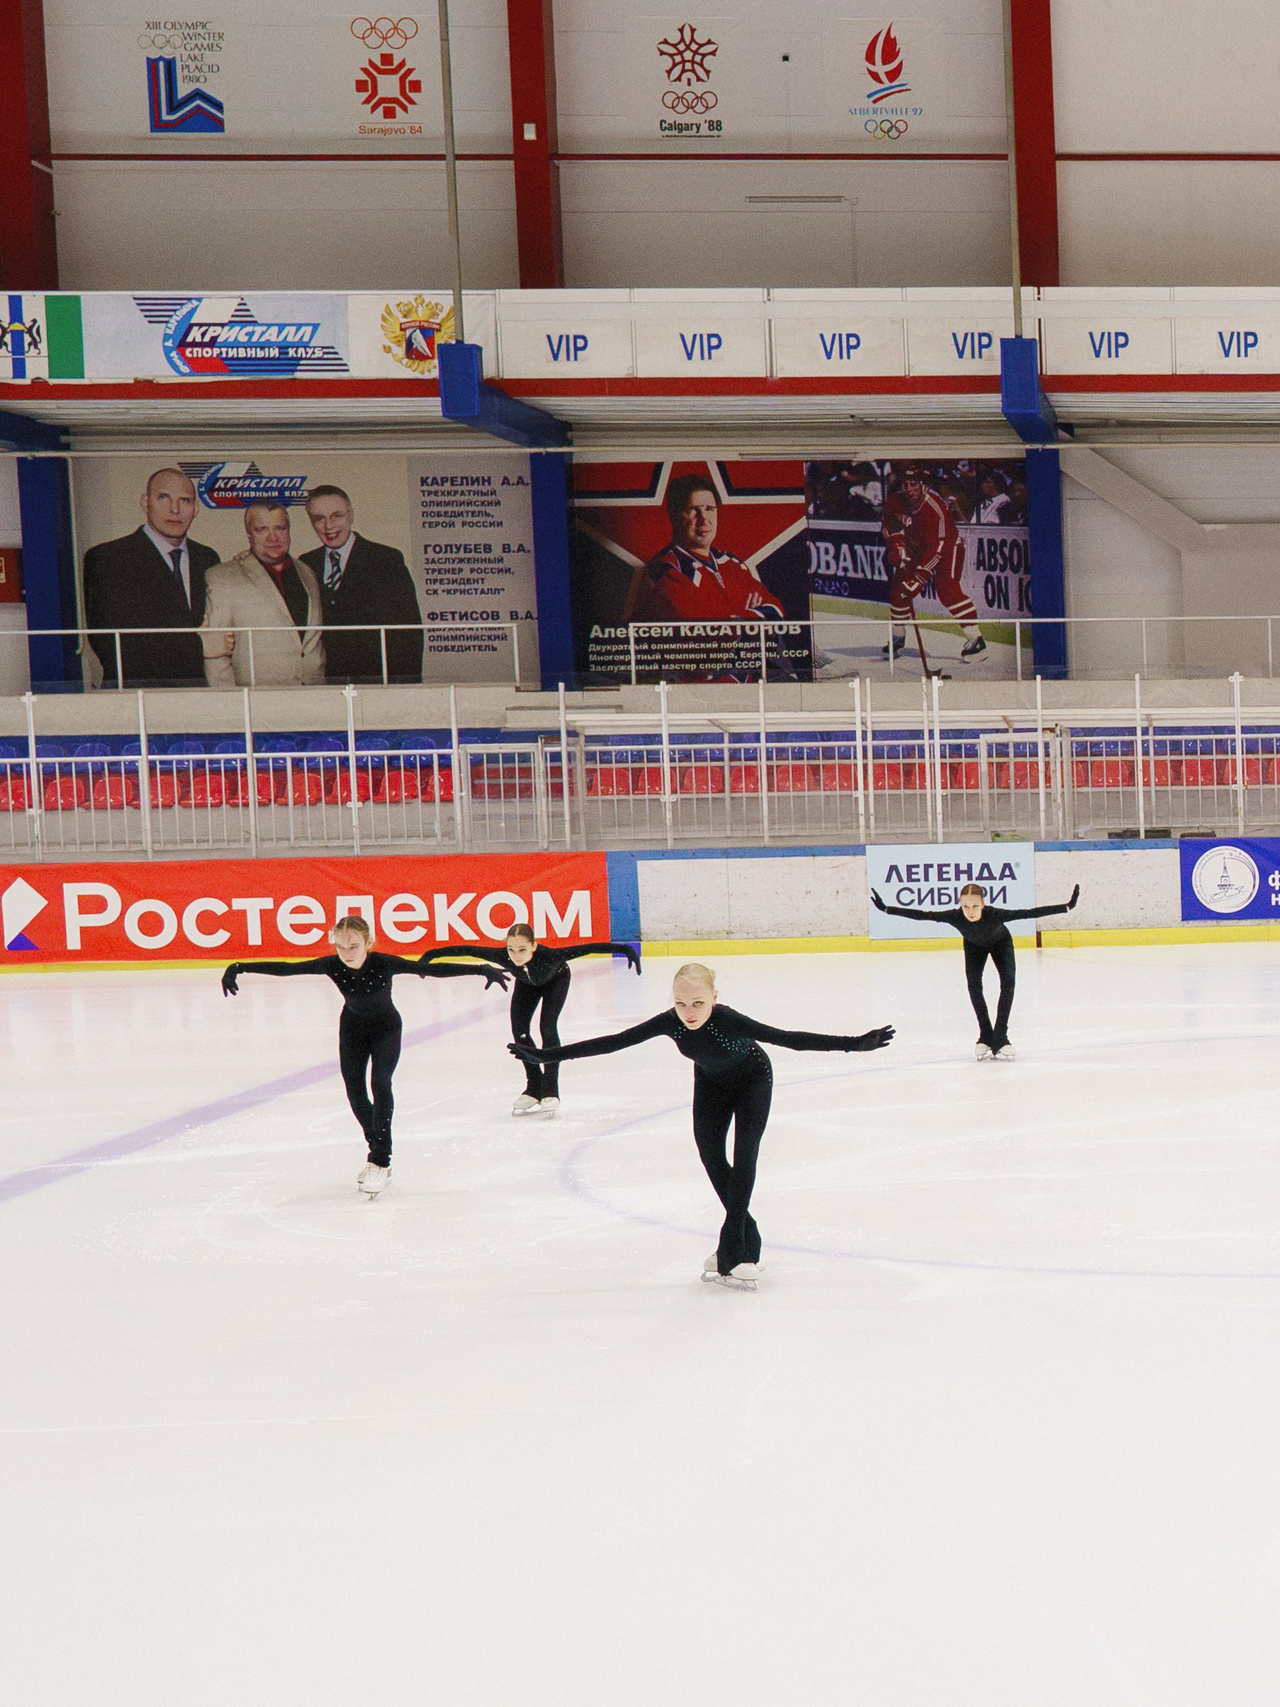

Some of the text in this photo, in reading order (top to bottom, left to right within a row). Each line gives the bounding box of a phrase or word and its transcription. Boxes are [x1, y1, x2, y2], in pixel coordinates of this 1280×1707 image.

[145, 21, 213, 31] XIII OLYMPIC
[181, 32, 225, 41] WINTER
[183, 43, 222, 52] GAMES
[180, 53, 205, 63] LAKE
[181, 64, 220, 73] PLACID
[182, 75, 208, 84] 1980
[849, 107, 909, 116] ALBERTVILLE
[358, 125, 423, 136] Sarajevo '84
[660, 119, 723, 134] Calgary '88
[186, 325, 313, 342] КРИСТАЛЛ
[546, 333, 589, 363] VIP
[680, 333, 723, 361] VIP
[819, 333, 861, 360] VIP
[952, 331, 993, 360] VIP
[1088, 331, 1130, 358] VIP
[1217, 331, 1259, 358] VIP
[185, 346, 324, 358] СПОРТИВНЫЙ КЛУБ
[215, 478, 302, 488] КРИСТАЛЛ
[420, 475, 530, 487] КАРЕЛИН А.А.
[213, 490, 279, 498] СПОРТИВНЫЙ
[421, 488, 498, 498] ТРЕХКРАТНЫЙ
[421, 499, 501, 508] ОЛИМПИЙСКИЙ
[421, 509, 494, 519] ПОБЕДИТЕЛЬ,
[422, 520, 504, 529] ГЕРОЙ РОССИИ
[424, 543, 531, 555] ГОЛУБЕВ В.А.
[424, 556, 505, 565] ЗАСЛУЖЕННЫЙ
[425, 567, 515, 575] ТРЕНЕР РОССИИ,
[425, 577, 486, 586] ПРЕЗИДЕНТ
[426, 588, 439, 596] СК
[984, 574, 1010, 611] ON
[427, 610, 538, 621] ФЕТИСОВ В.А.
[680, 625, 802, 637] КАСАТОНОВ
[428, 632, 508, 642] ОЛИМПИЙСКИЙ
[429, 645, 498, 653] ПОБЕДИТЕЛЬ
[588, 640, 778, 652] Двукратый олимпийский победитль
[588, 652, 662, 662] Многокртный
[664, 652, 707, 660] чемпион
[709, 651, 738, 660] мира,
[782, 649, 810, 658] СССР
[662, 662, 697, 672] мастер
[699, 662, 733, 670] спорта
[735, 660, 762, 669] СССР
[885, 862, 1017, 884] ЛЕГЕНДА
[63, 882, 592, 950] Ростелеком
